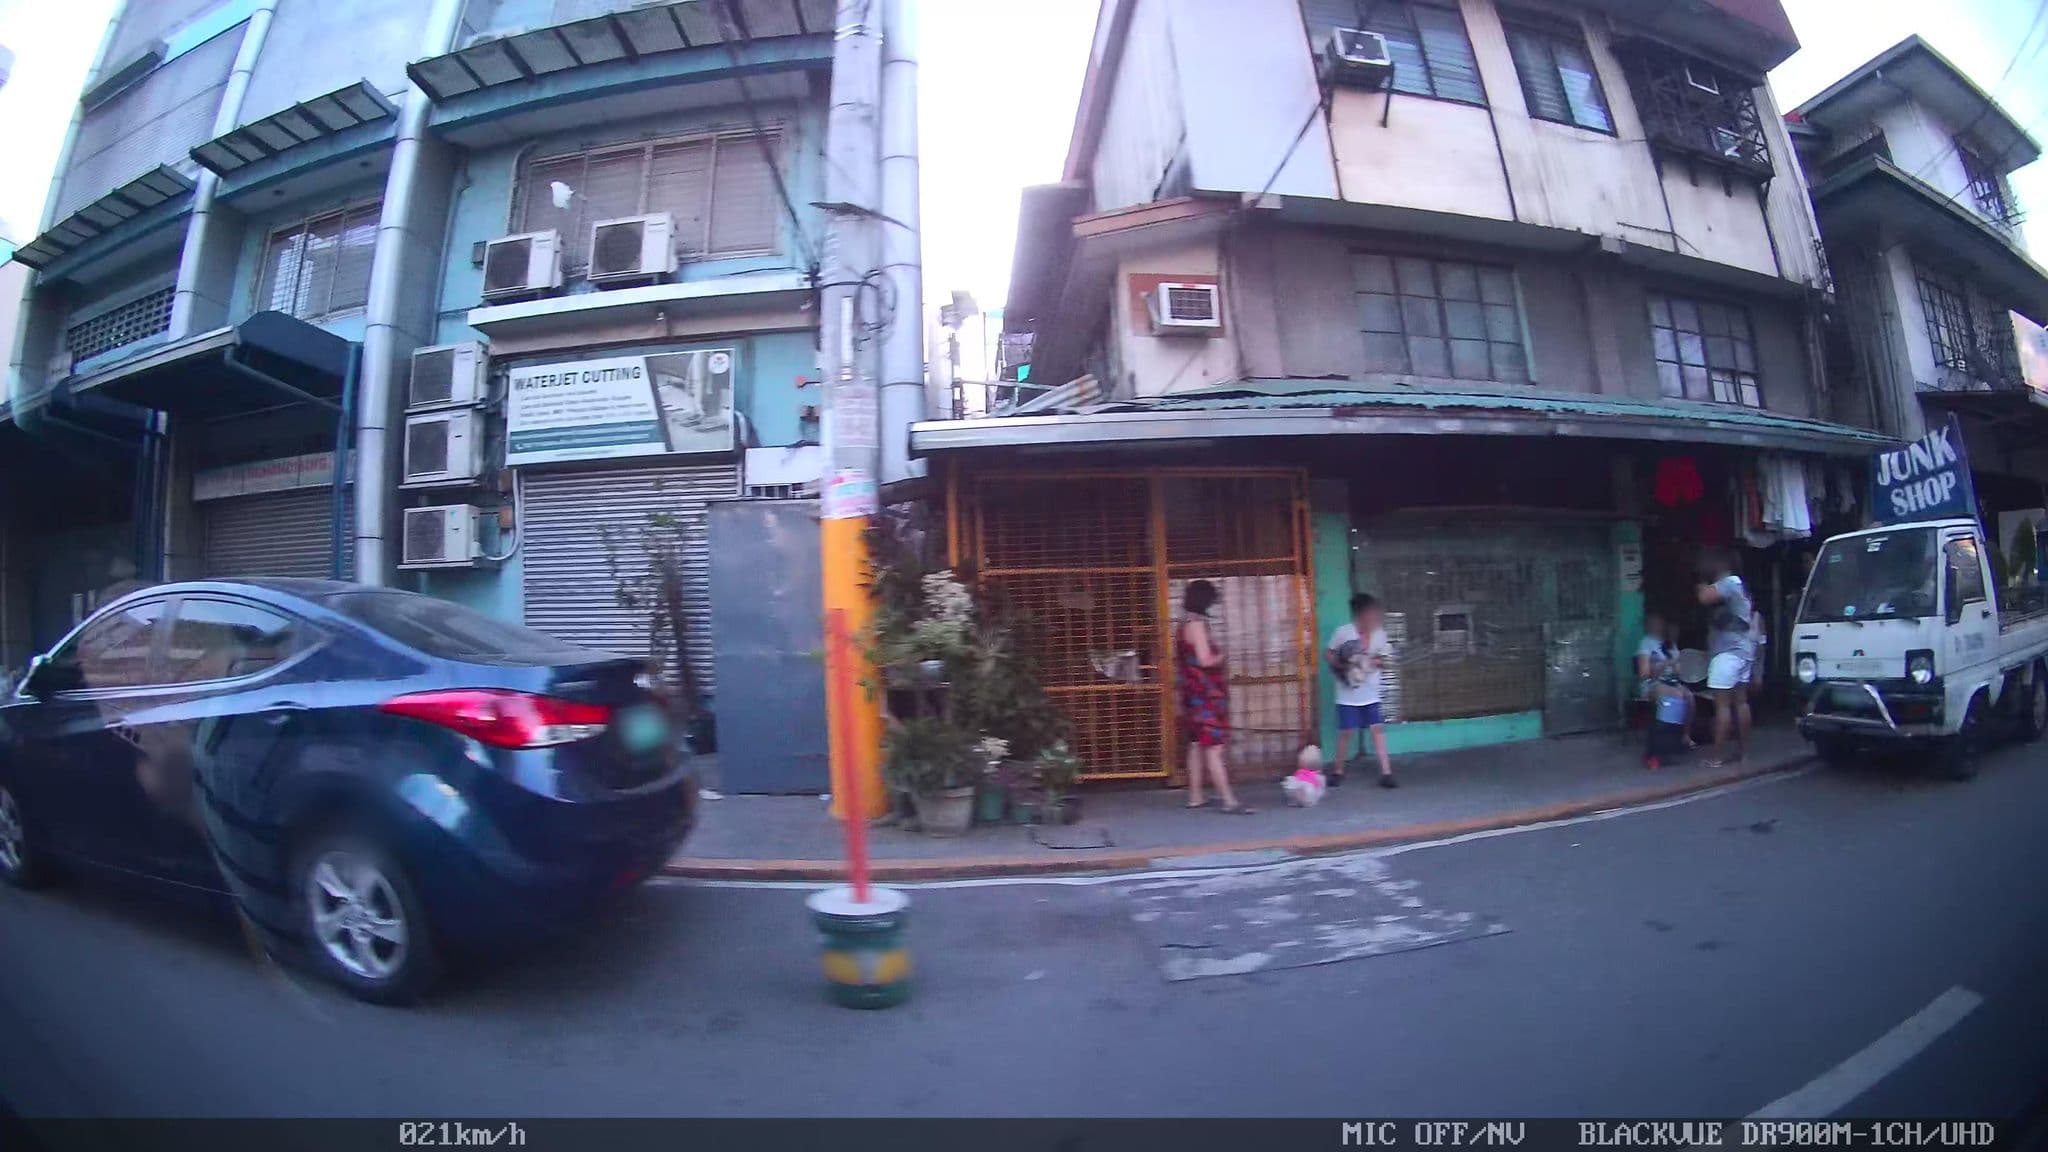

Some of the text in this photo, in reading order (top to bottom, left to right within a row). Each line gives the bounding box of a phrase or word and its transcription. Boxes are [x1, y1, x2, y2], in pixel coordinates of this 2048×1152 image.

[514, 366, 641, 391] WATERJET CUTTING
[1877, 425, 1957, 486] JUNK
[1890, 471, 1956, 516] SHOP
